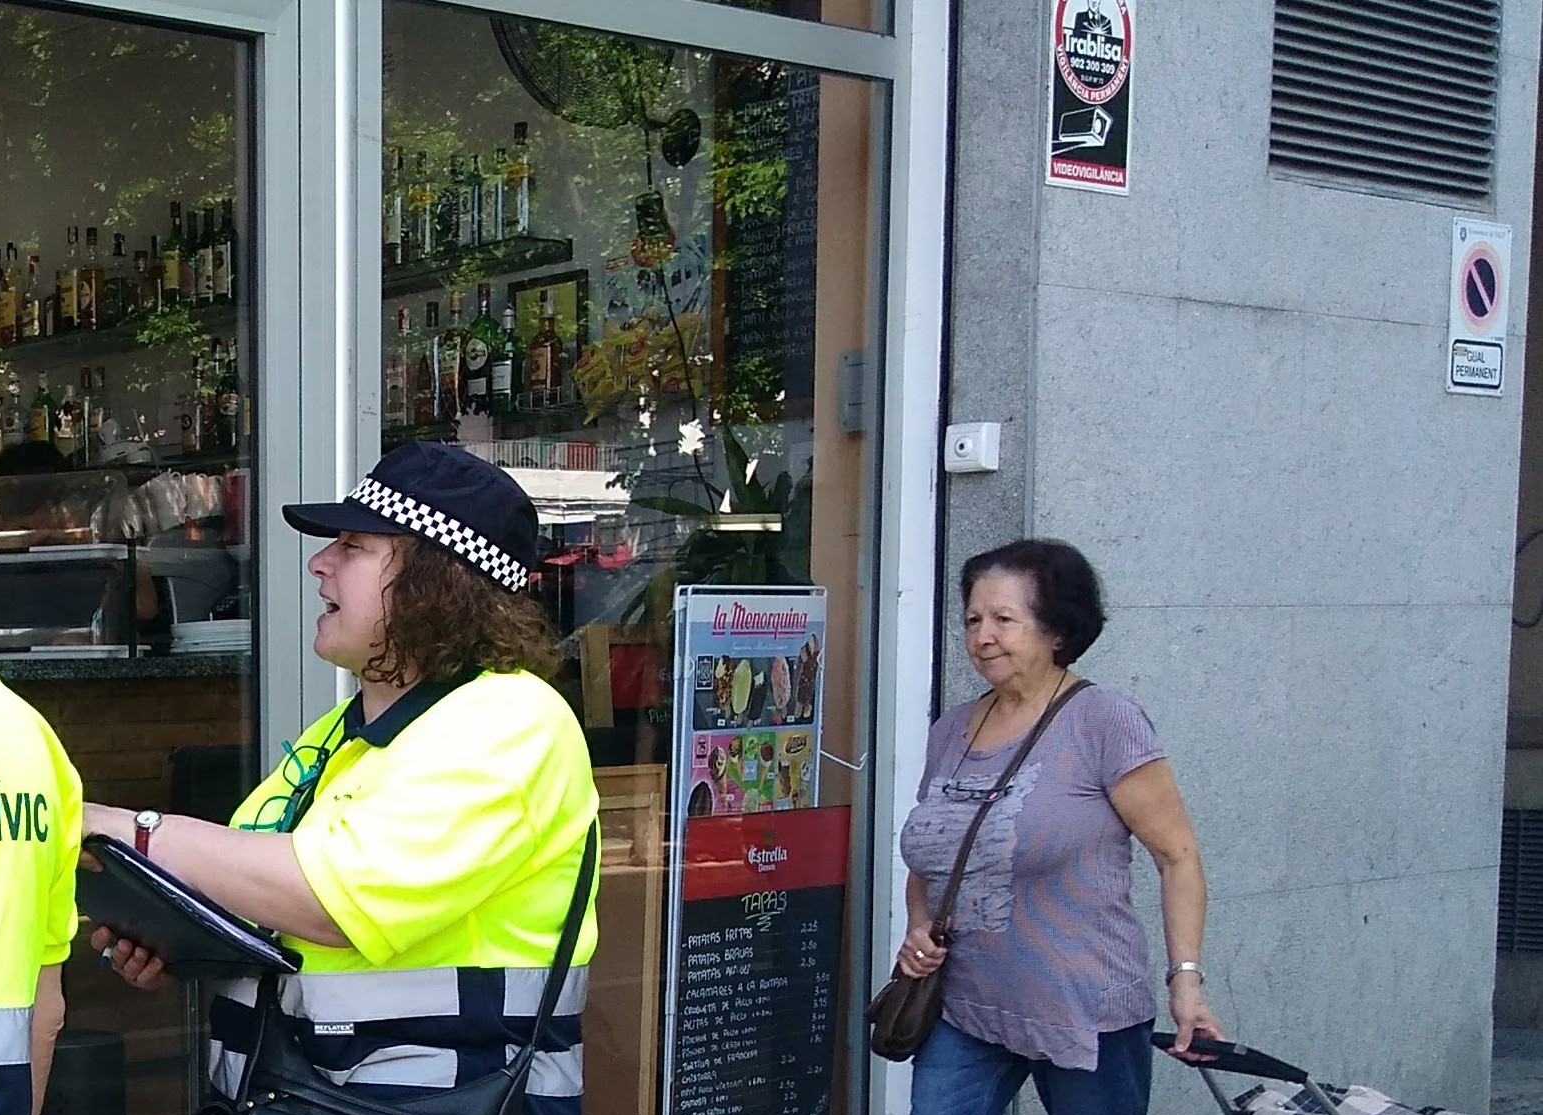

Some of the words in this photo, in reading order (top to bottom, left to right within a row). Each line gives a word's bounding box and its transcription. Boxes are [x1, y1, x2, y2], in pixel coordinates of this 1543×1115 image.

[1063, 29, 1122, 61] Trablisa
[1070, 56, 1085, 70] 902
[1085, 59, 1100, 72] 300
[1100, 62, 1115, 75] 309
[1090, 56, 1128, 101] PERMANENT
[1456, 364, 1497, 380] PERMANENT
[712, 602, 727, 630] la
[730, 601, 808, 640] Menorquina
[748, 844, 788, 864] Estrella
[740, 890, 788, 914] TAPAS
[687, 931, 721, 949] PATATAS
[725, 927, 754, 942] FRITAS
[687, 952, 721, 967] PATATAS
[687, 967, 722, 984] PATATAS
[685, 984, 733, 1001] CALAMARES
